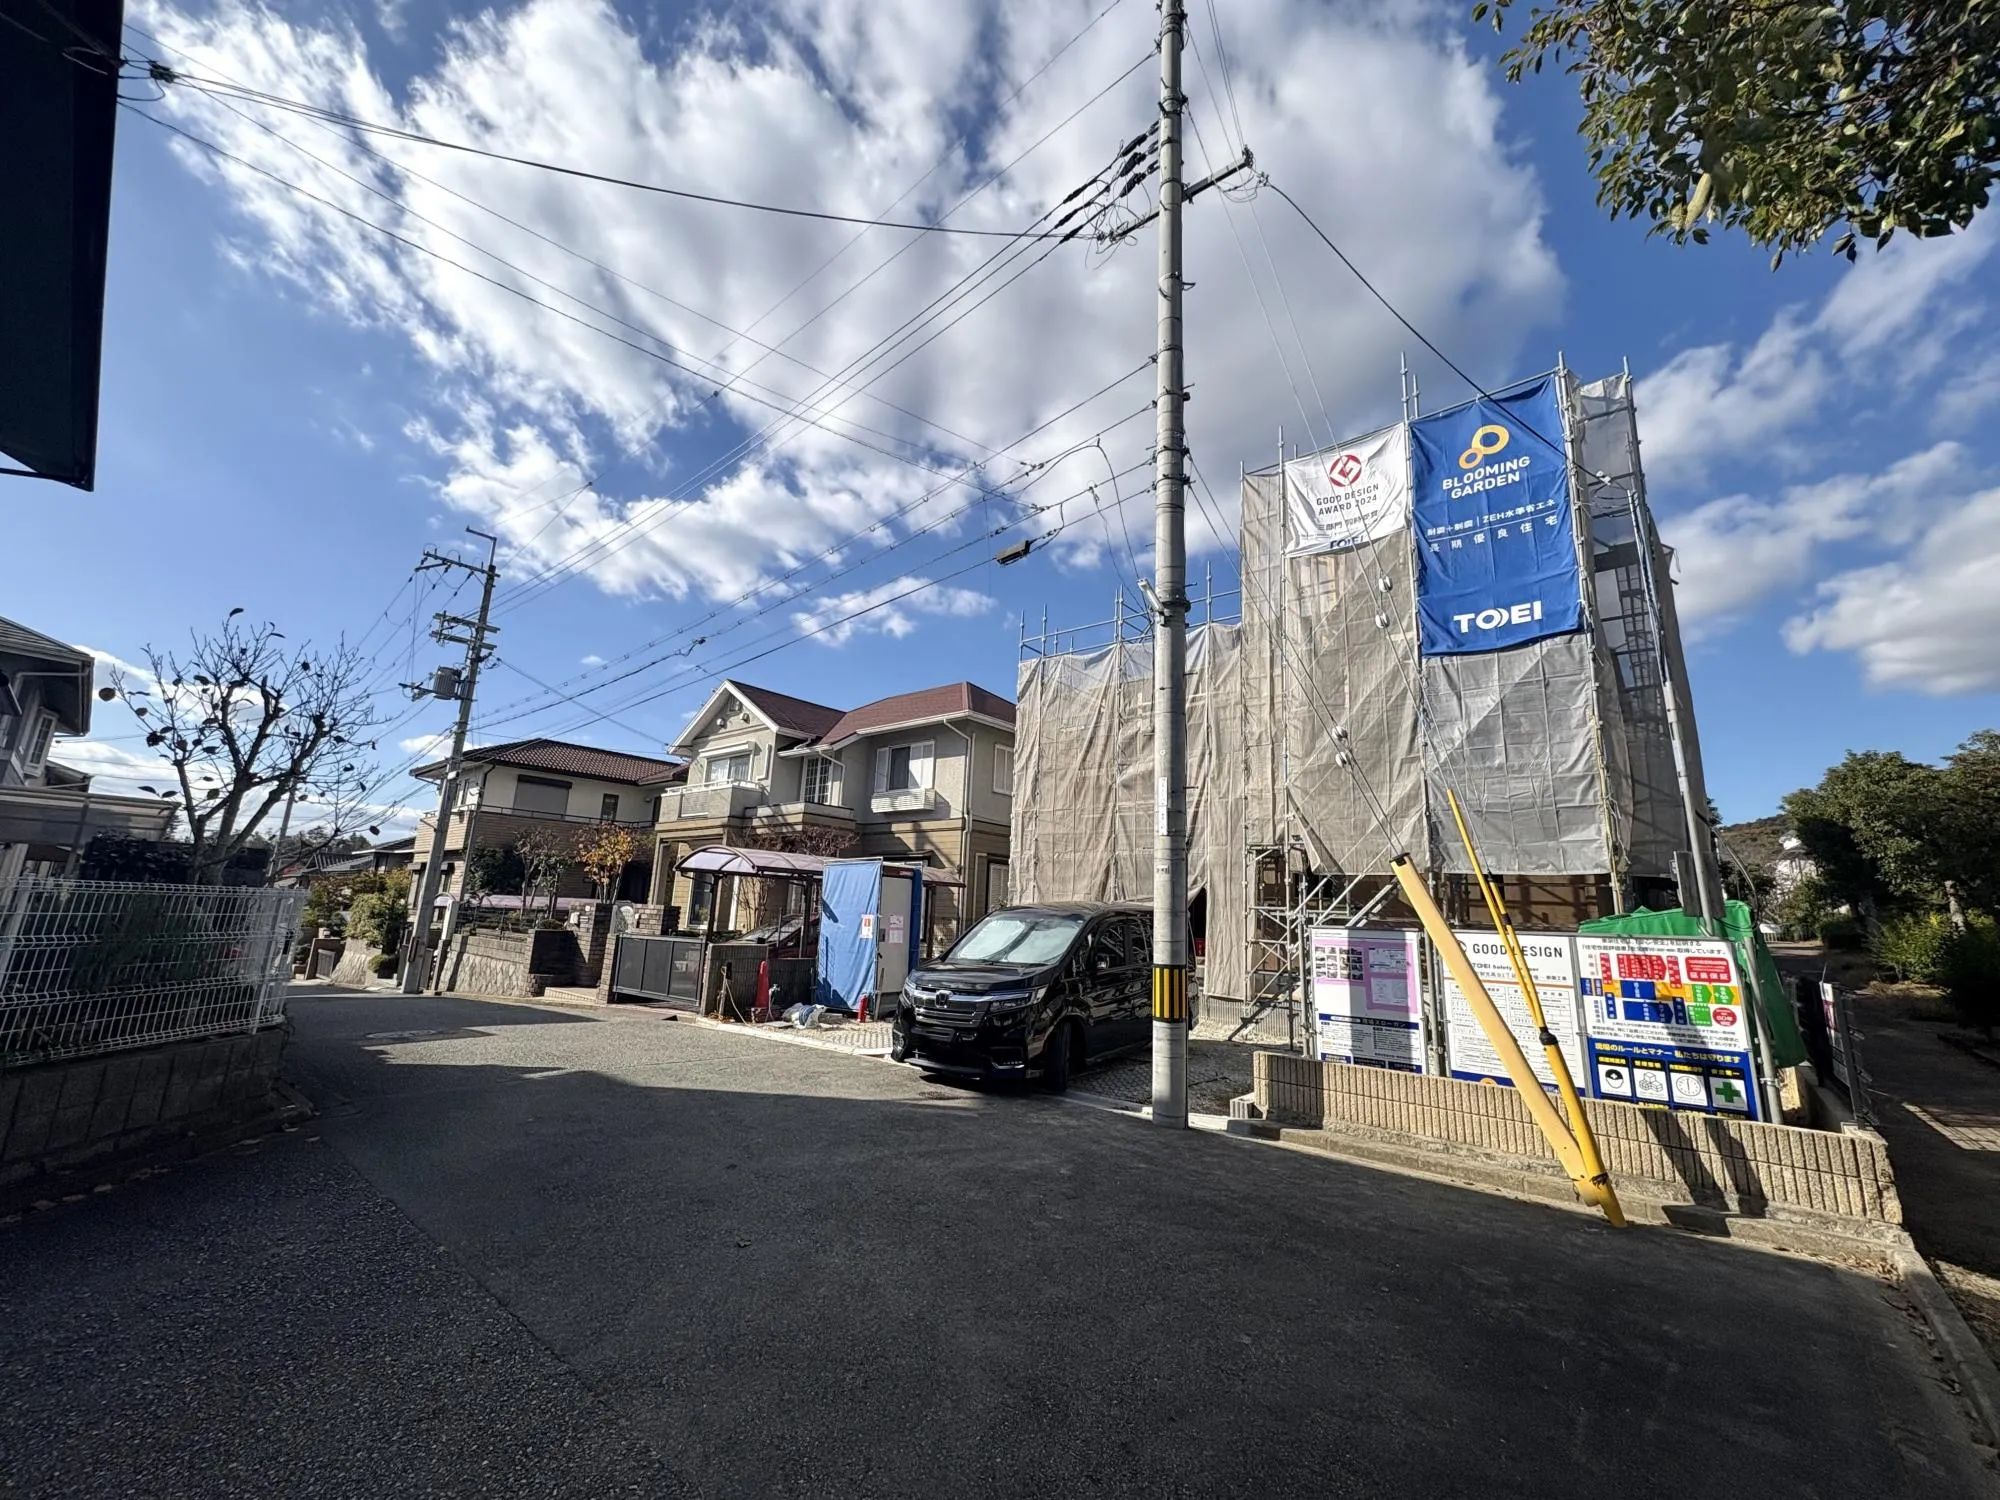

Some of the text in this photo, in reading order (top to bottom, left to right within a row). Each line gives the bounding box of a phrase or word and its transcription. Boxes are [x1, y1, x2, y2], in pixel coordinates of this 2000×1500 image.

[1442, 456, 1530, 490] BLOOMING
[1316, 483, 1379, 506] GOOD DESIGN
[1451, 471, 1521, 499] GARDEN
[1318, 494, 1378, 516] AWARD 2024
[1453, 600, 1543, 634] TOEI
[1472, 943, 1563, 958] GOOD ESIGN
[1674, 1050, 1741, 1064] 私たちは守ります
